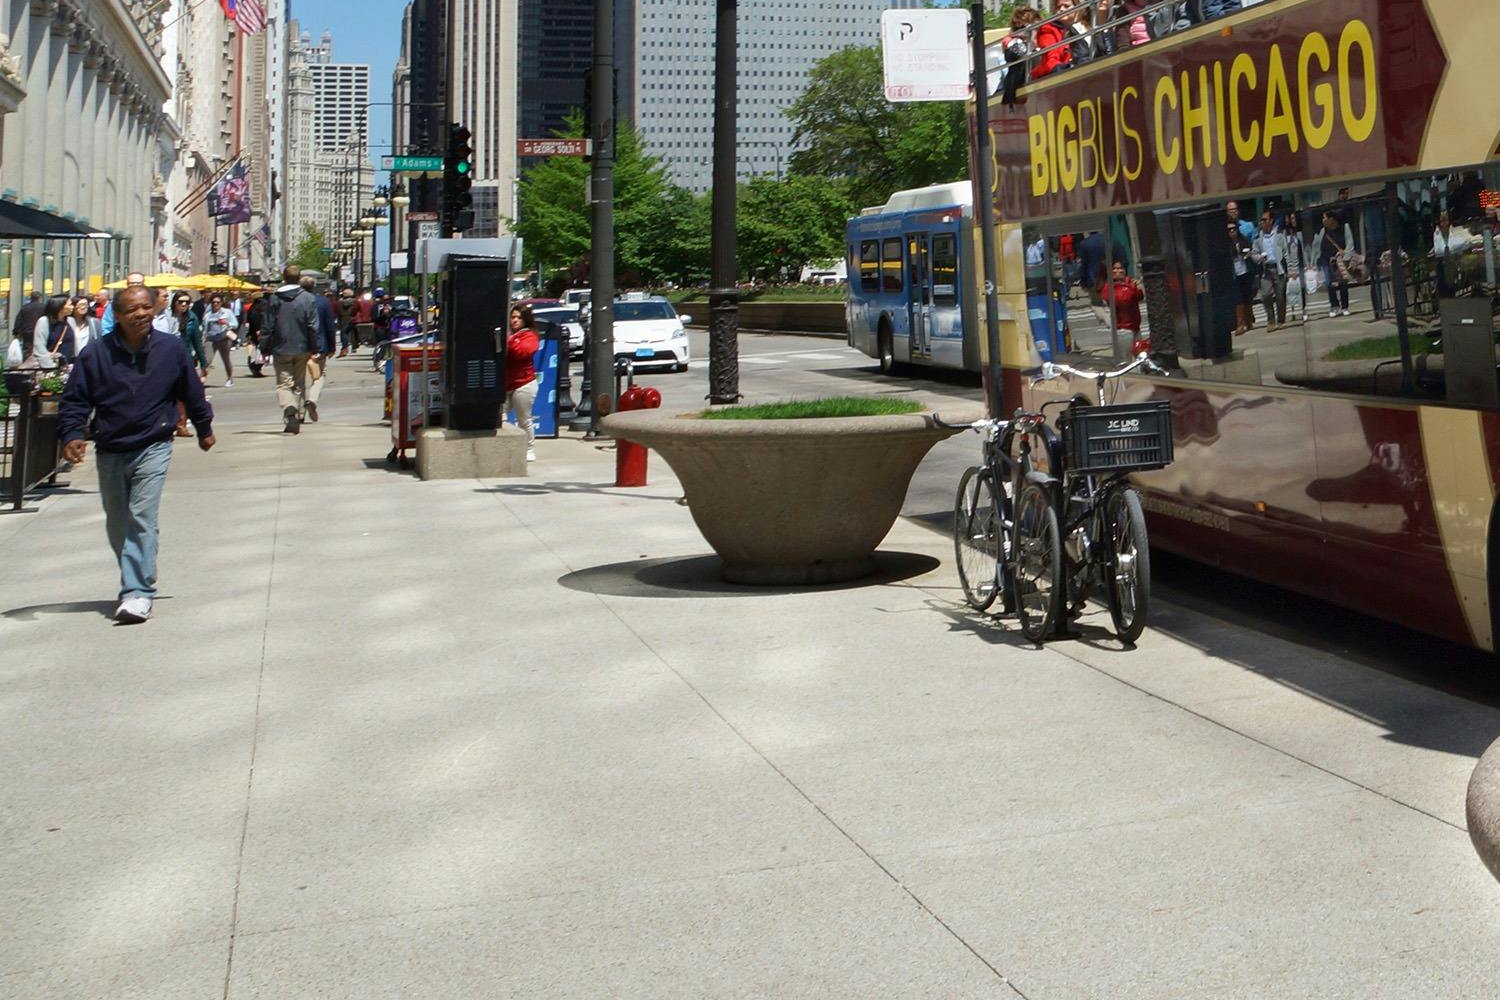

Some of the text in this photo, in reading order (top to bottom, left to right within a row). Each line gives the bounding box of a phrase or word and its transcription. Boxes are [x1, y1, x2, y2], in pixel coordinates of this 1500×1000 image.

[1154, 19, 1377, 175] CHICAGO
[402, 158, 433, 168] Adams
[1121, 418, 1139, 427] LIND
